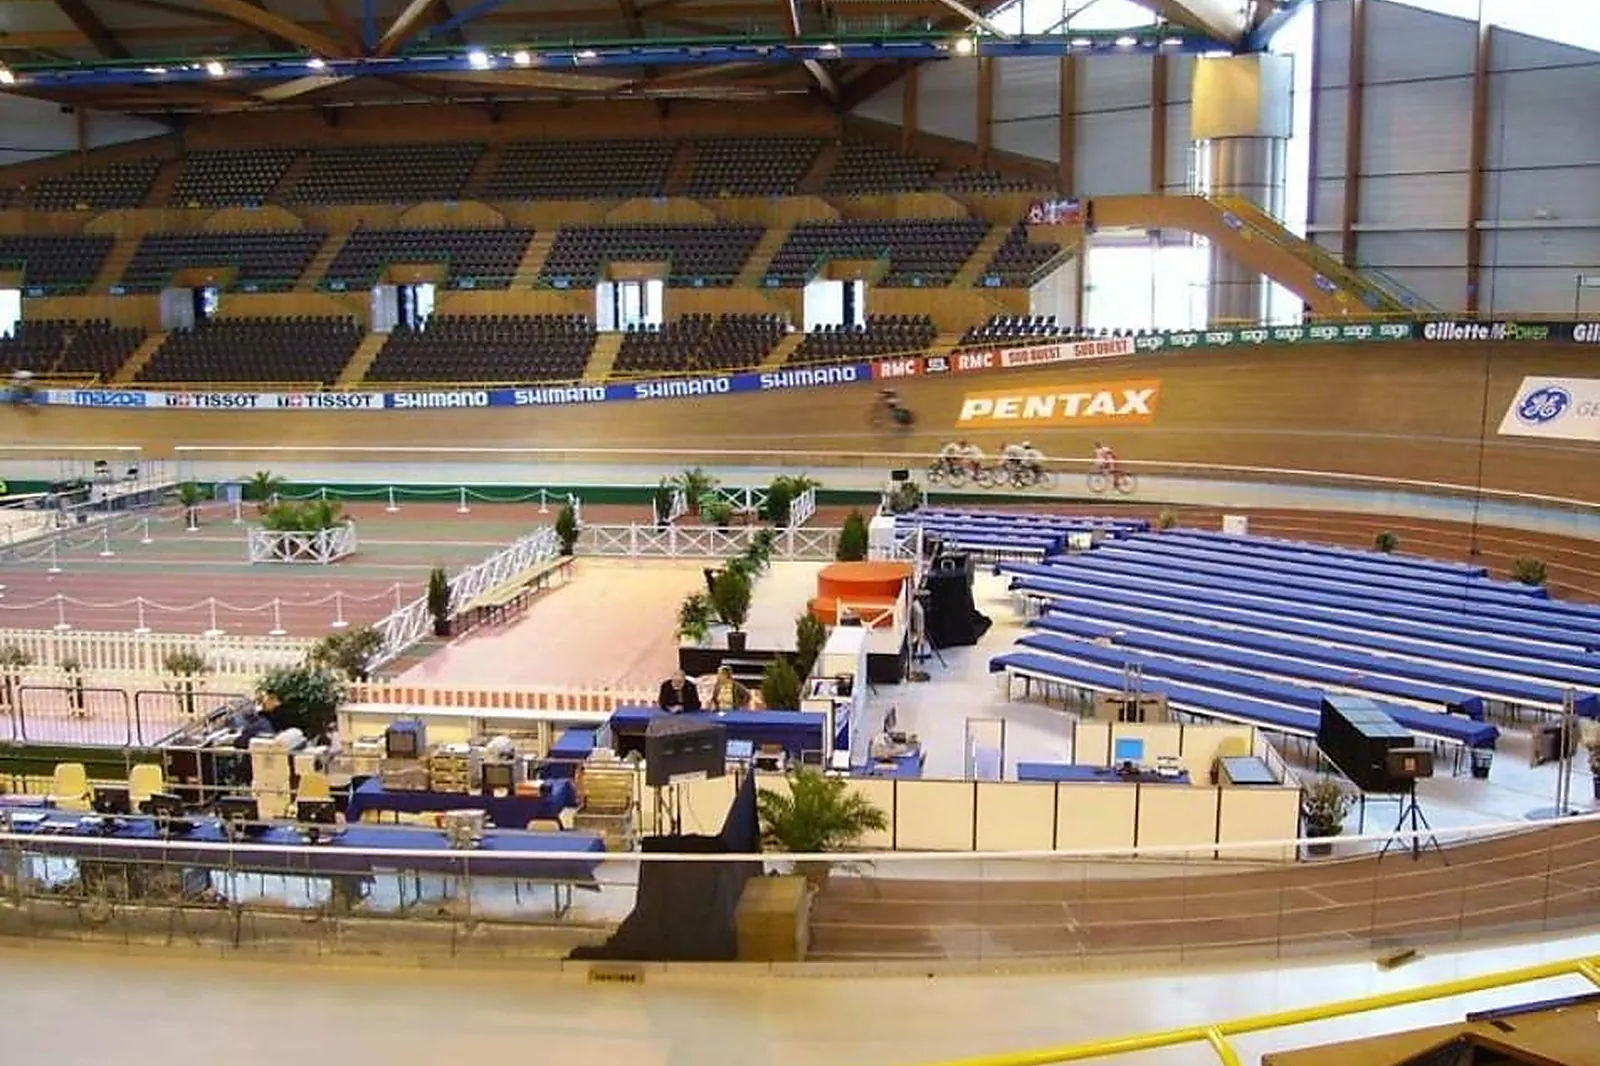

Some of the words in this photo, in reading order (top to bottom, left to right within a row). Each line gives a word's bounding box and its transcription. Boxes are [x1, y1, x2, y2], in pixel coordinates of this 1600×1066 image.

[1424, 322, 1488, 340] Gillette
[881, 360, 915, 377] RMC
[958, 352, 993, 369] RMC
[760, 368, 856, 388] SHIMANO
[514, 387, 605, 405] SHIMANO
[635, 378, 730, 398] SHIMANO
[195, 393, 257, 407] TISSOT
[307, 393, 373, 407] TISSOT
[393, 391, 488, 408] SHIMANO
[960, 389, 1156, 420] PENTAX
